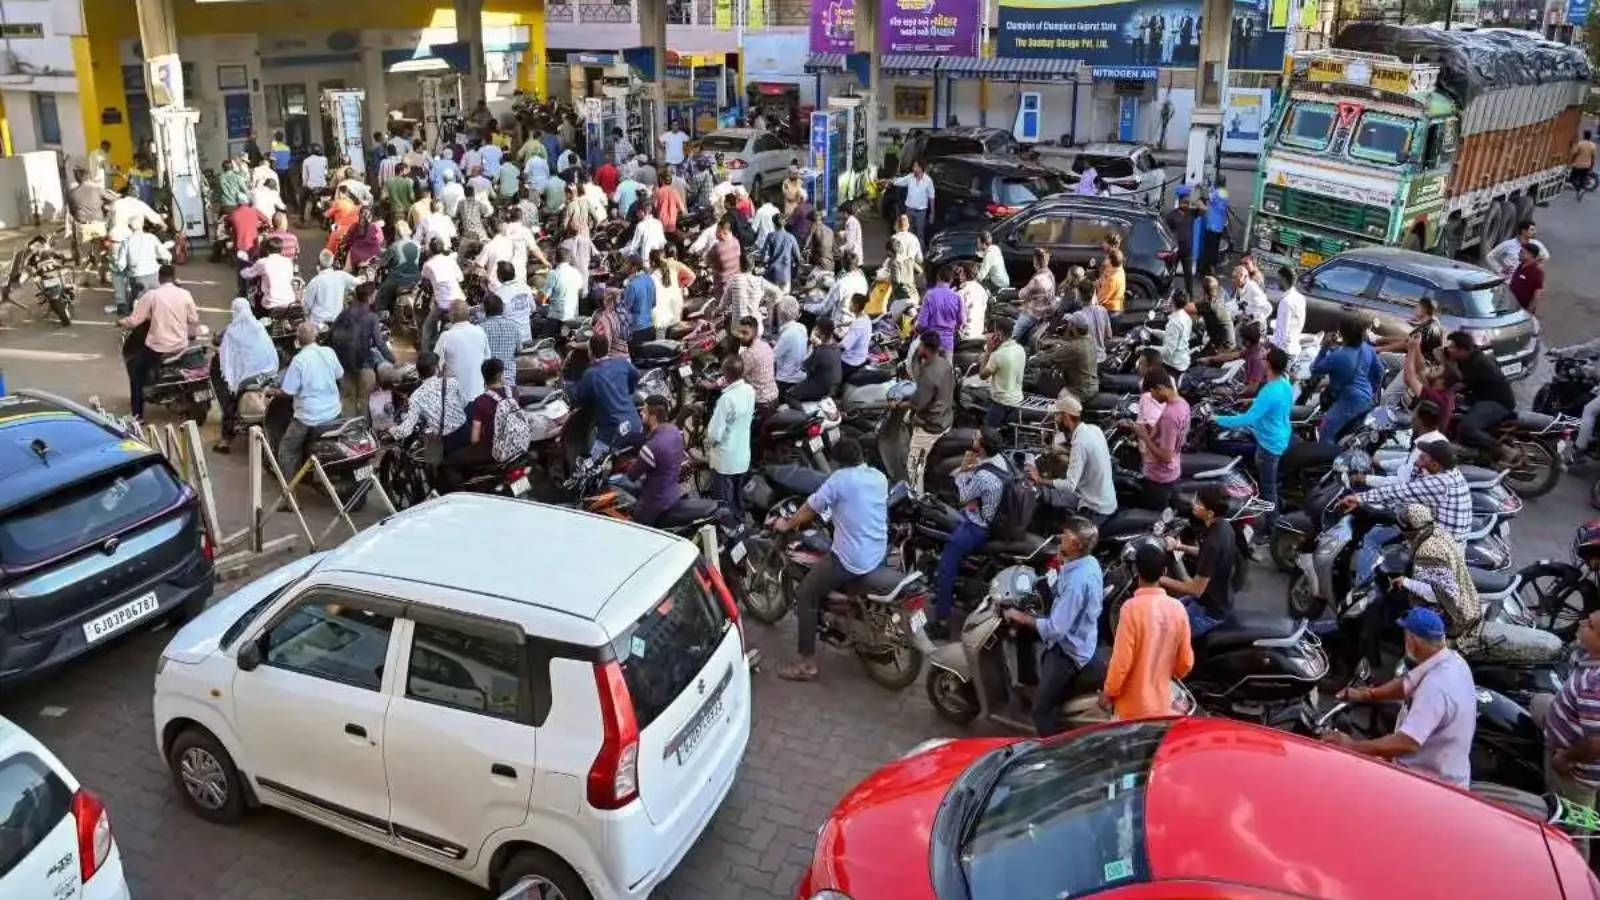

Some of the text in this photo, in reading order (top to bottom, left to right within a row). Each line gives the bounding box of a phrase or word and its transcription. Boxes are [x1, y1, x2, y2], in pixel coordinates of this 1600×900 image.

[1006, 21, 1117, 32] Champion of Champions Gujarat State
[1015, 38, 1027, 47] The
[1028, 38, 1055, 49] Bombay
[1093, 68, 1157, 79] NITROGEN AIR
